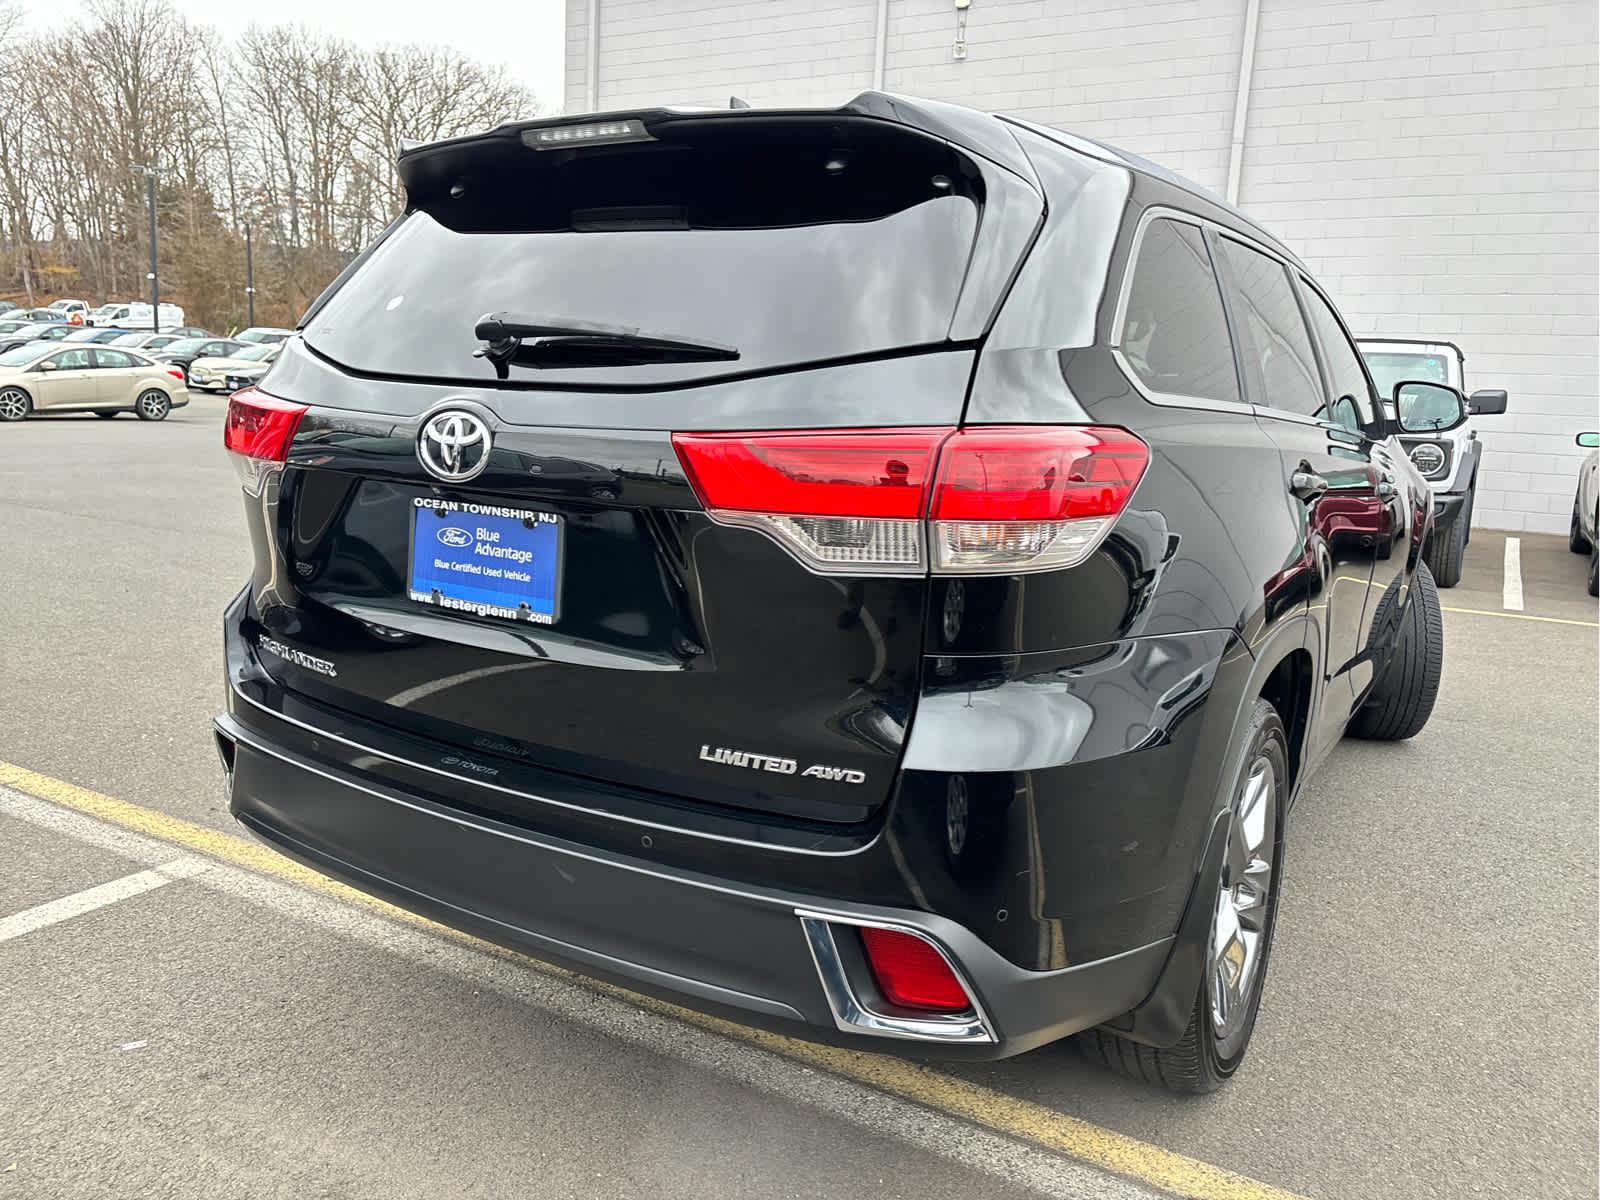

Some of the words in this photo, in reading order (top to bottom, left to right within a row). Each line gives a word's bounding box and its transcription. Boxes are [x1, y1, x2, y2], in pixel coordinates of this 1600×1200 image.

[414, 498, 458, 511] OCEAN
[538, 512, 557, 523] NJ
[443, 529, 467, 545] Ford
[476, 528, 500, 542] Blue
[474, 543, 533, 563] Advantage
[434, 559, 450, 568] Blue
[451, 562, 482, 575] Certified
[483, 567, 502, 577] Used
[503, 570, 531, 582] Vehicle
[259, 634, 338, 677] HIGHLANDER
[459, 759, 500, 776] TOYOTA
[700, 745, 798, 775] LIMITED
[801, 765, 866, 784] AWD
